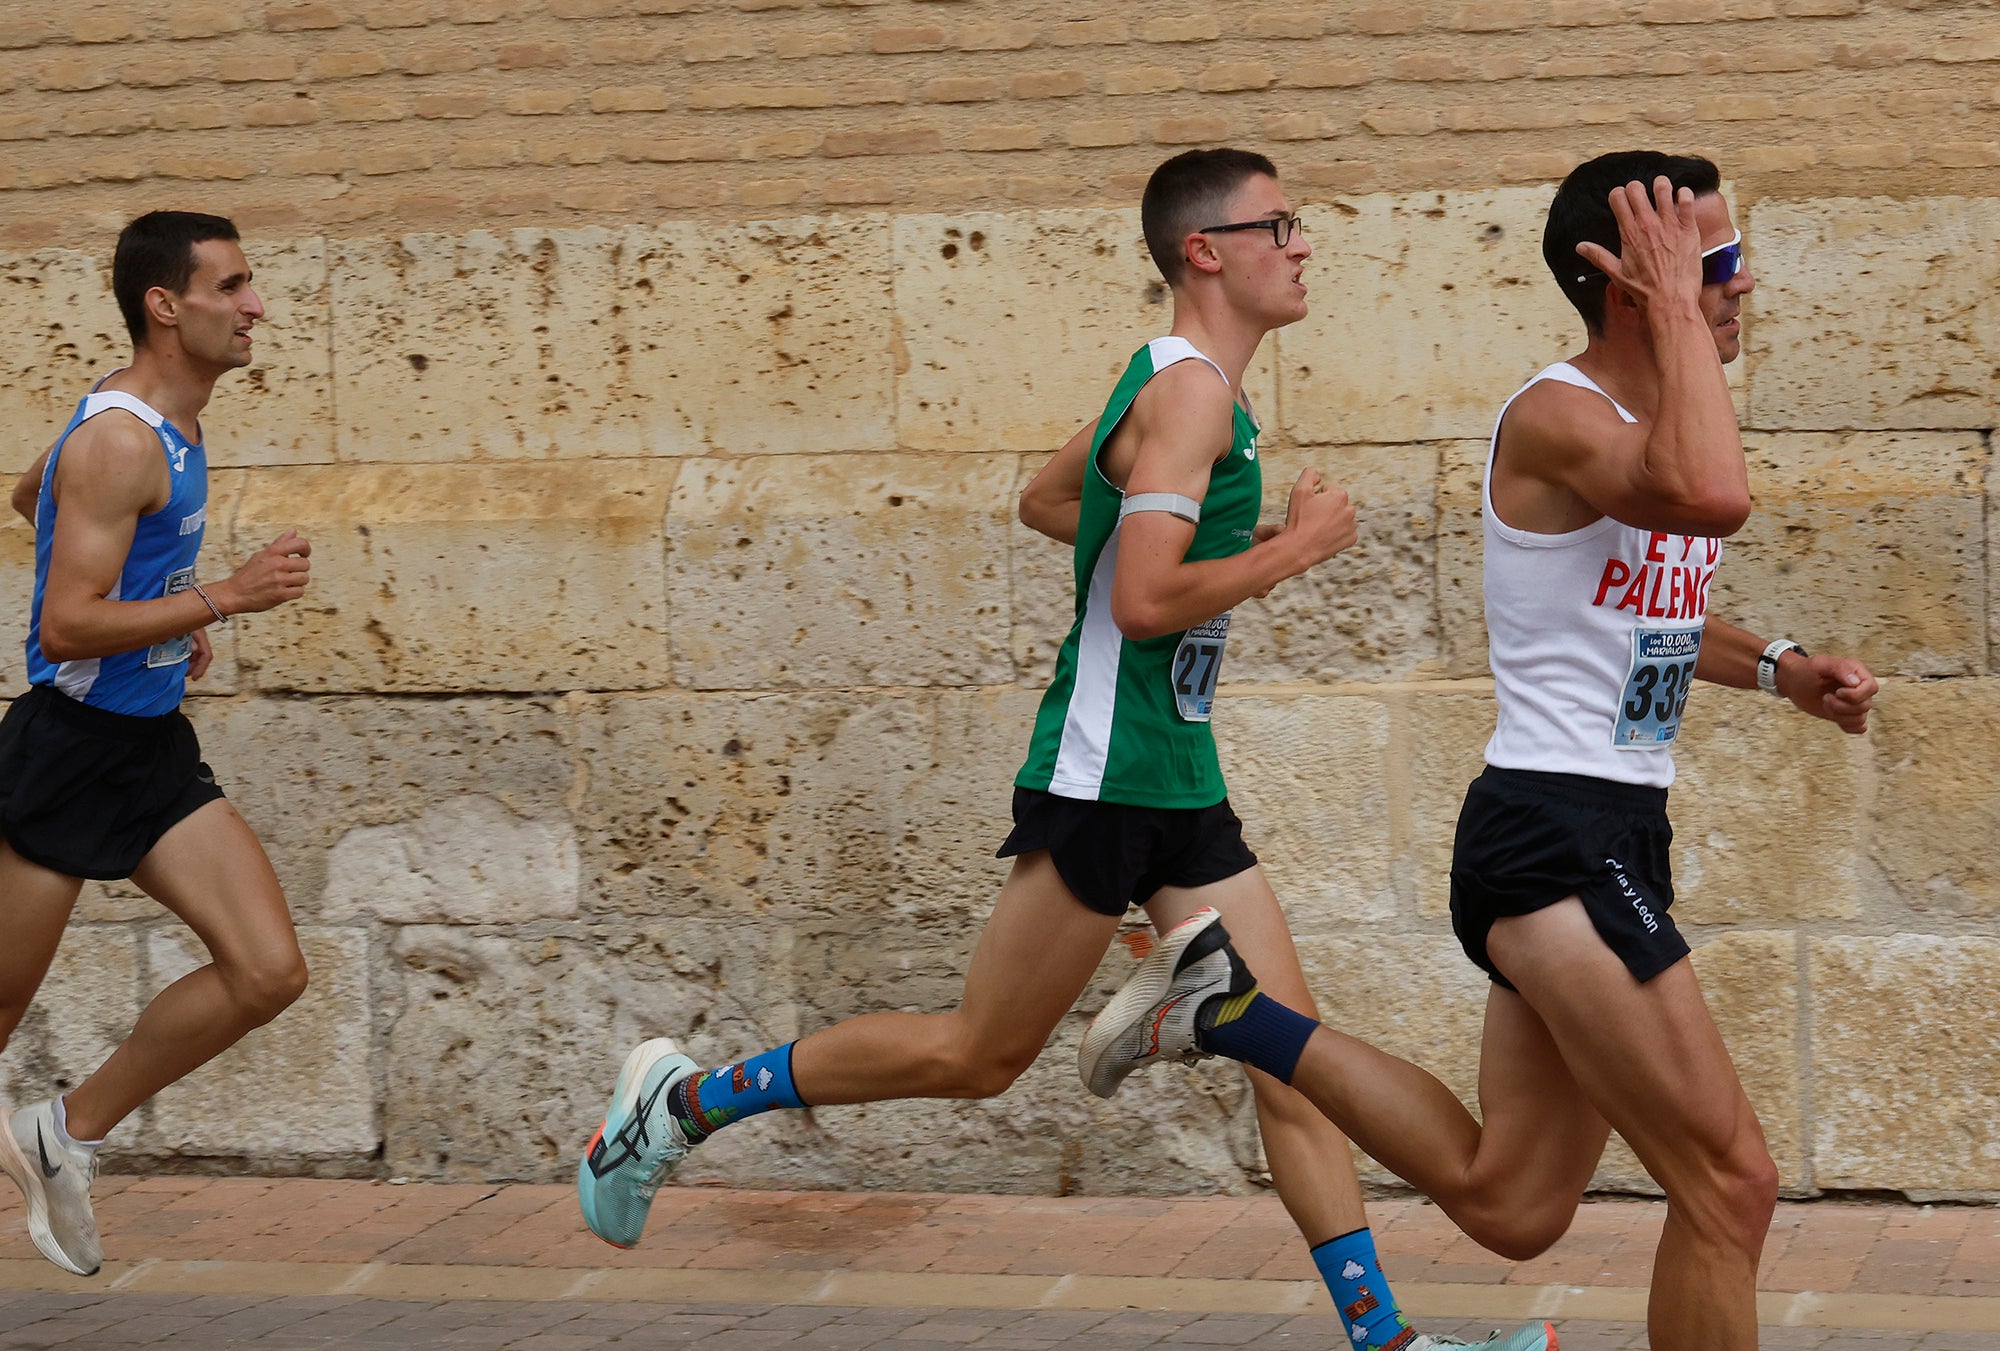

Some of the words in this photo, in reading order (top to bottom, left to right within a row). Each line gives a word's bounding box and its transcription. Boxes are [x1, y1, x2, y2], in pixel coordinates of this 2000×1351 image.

[1662, 634, 1692, 647] 10.000
[1176, 643, 1223, 696] 27
[1625, 661, 1695, 722] 335
[1624, 887, 1637, 897] y
[1632, 897, 1659, 934] León
